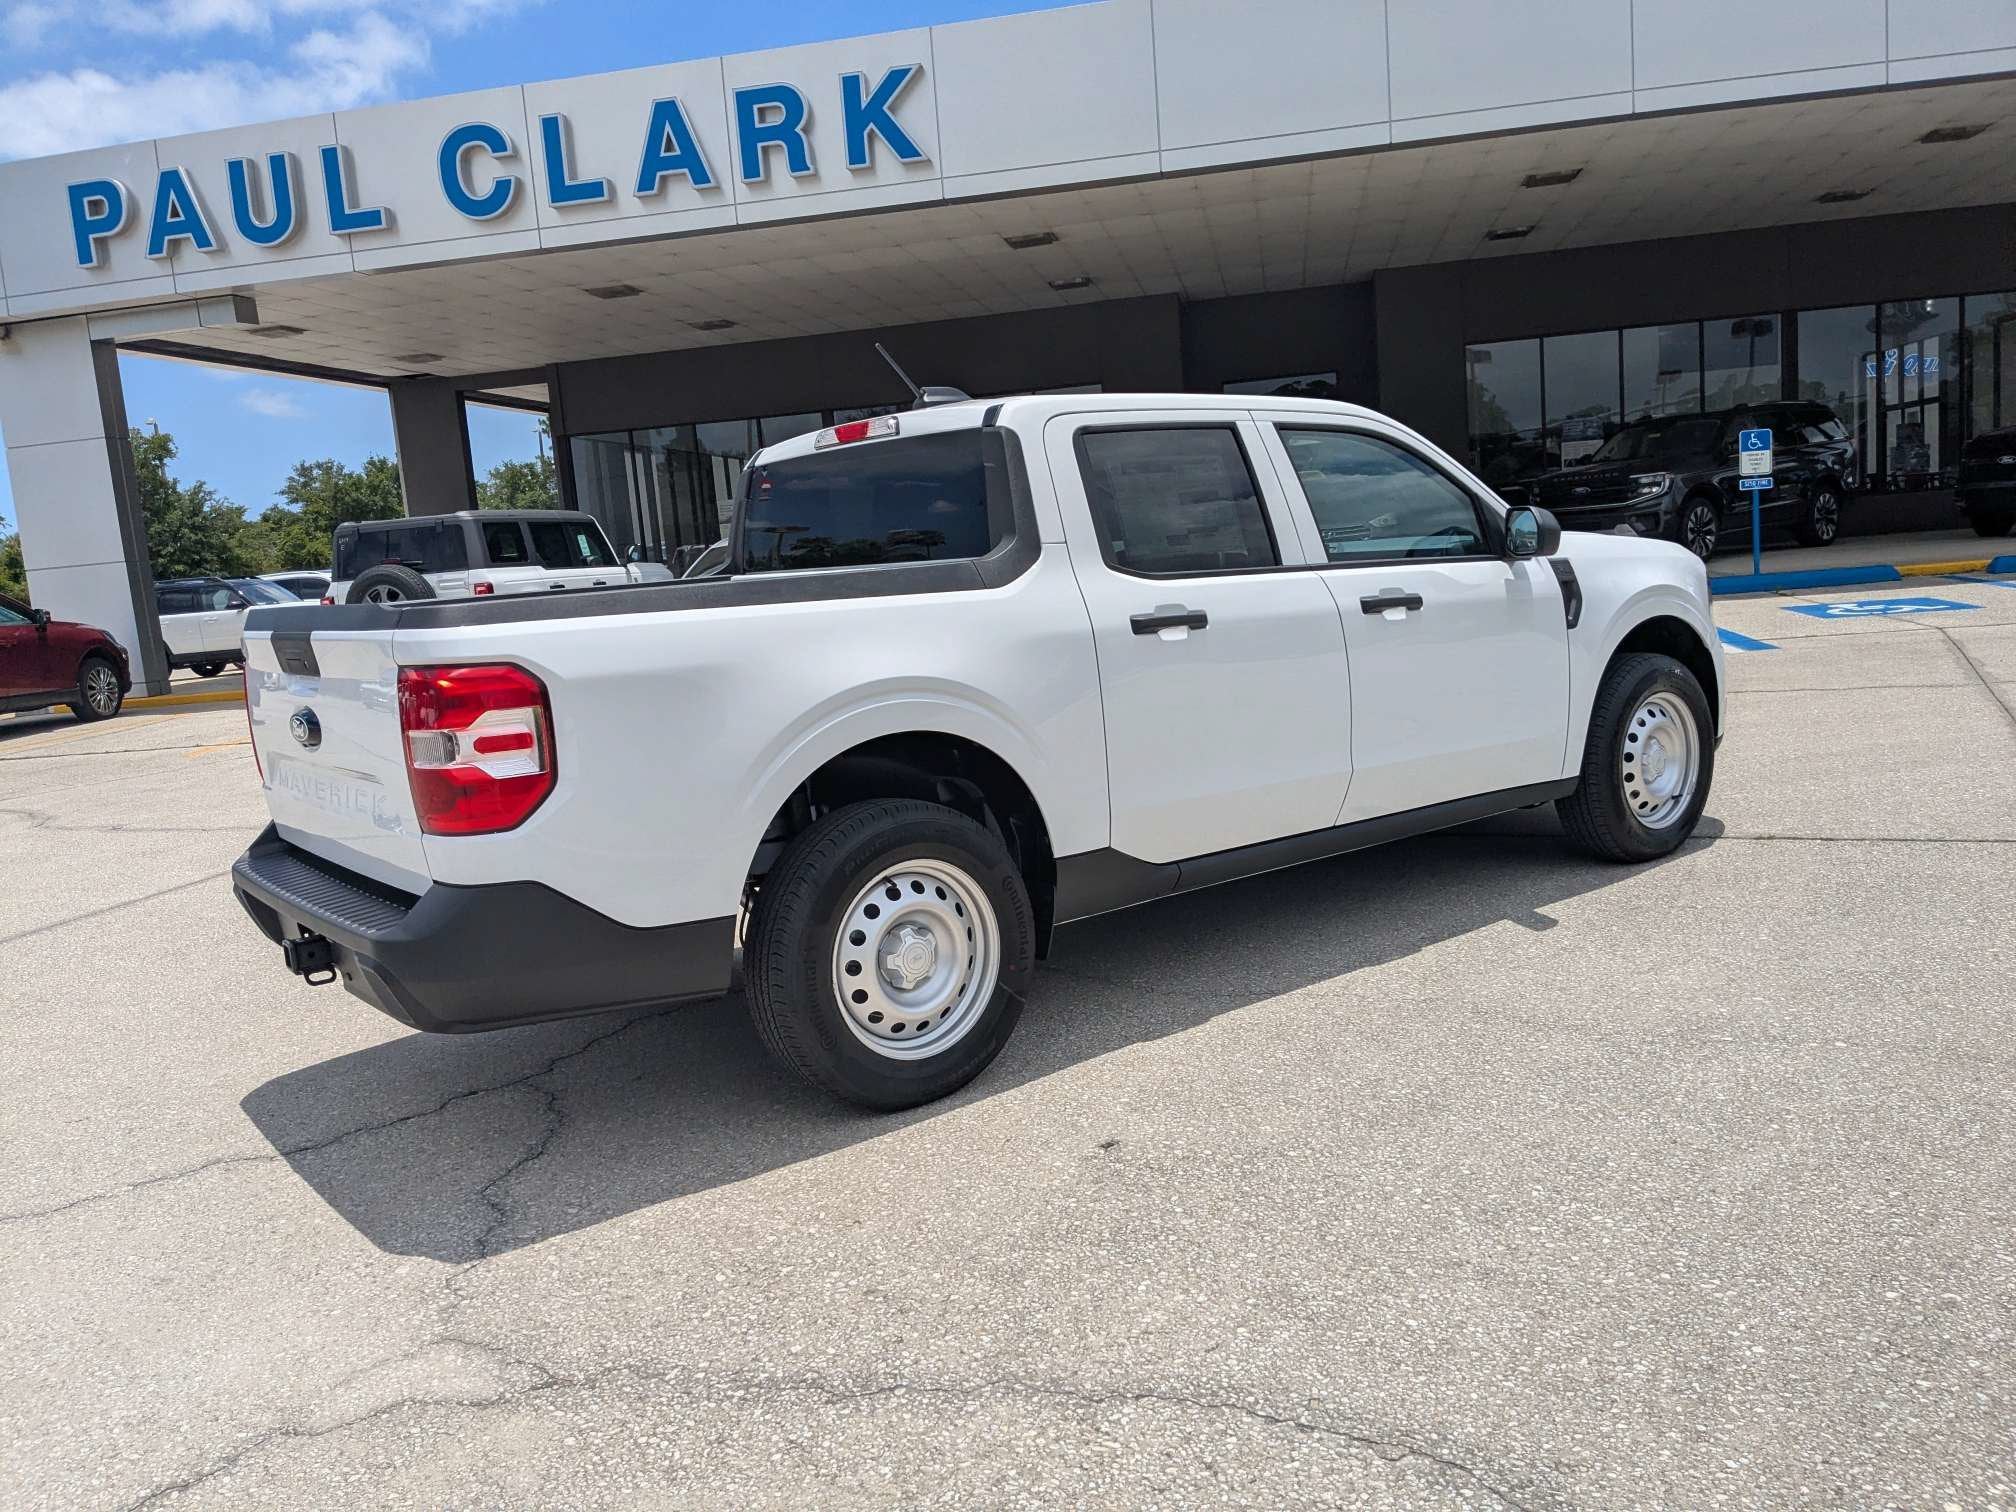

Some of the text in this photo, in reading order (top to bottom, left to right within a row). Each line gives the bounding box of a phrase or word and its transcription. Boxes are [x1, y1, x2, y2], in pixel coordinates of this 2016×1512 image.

[66, 62, 931, 269] PAUL CLARK
[275, 766, 388, 815] MAVERICK
